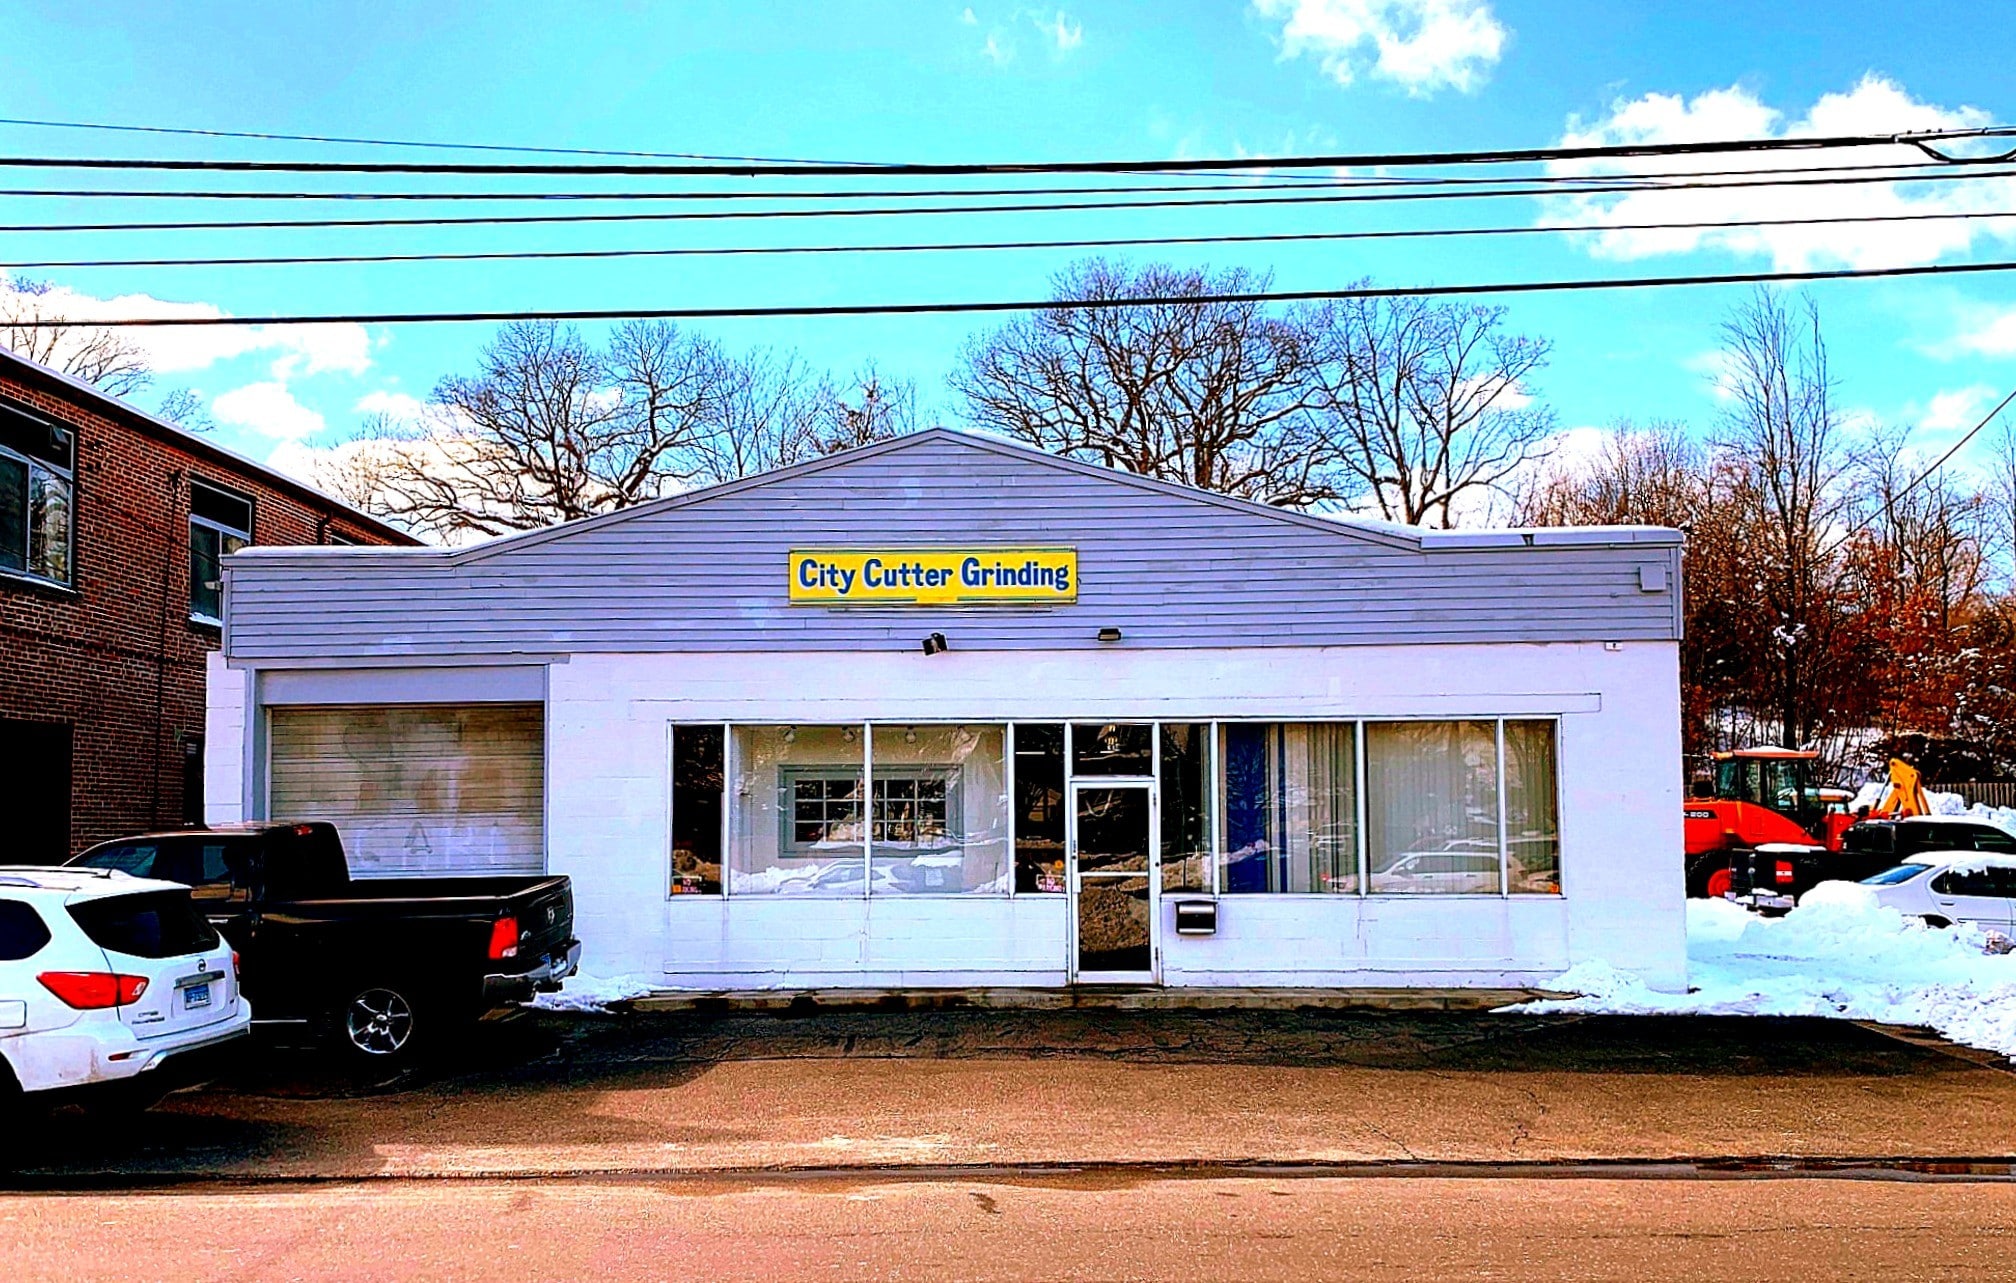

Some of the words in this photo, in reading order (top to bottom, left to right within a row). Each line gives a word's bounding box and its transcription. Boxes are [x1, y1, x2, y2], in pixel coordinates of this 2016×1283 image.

[800, 559, 856, 593] City
[864, 558, 953, 586] Cutter
[961, 557, 1069, 590] Grinding
